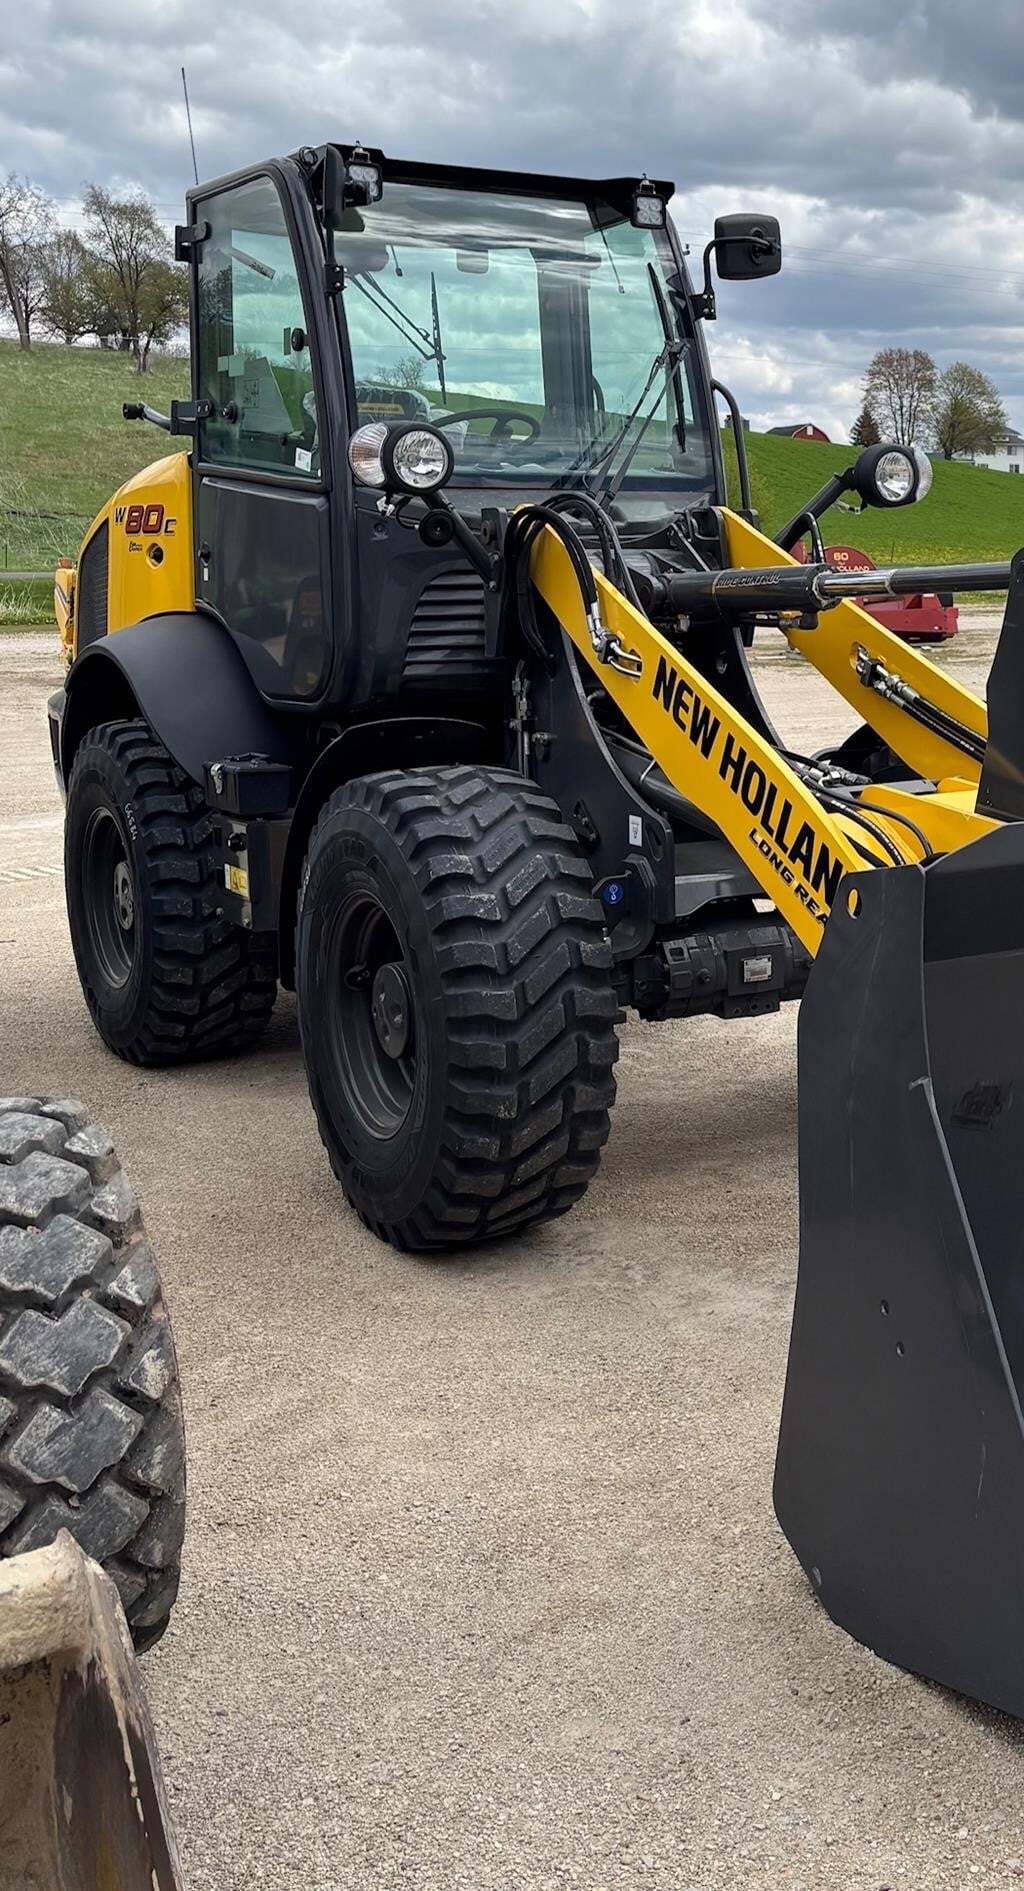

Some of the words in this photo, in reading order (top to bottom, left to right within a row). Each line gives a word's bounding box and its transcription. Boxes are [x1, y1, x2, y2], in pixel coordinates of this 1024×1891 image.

[833, 552, 849, 561] 60
[652, 655, 721, 760] NEW
[719, 732, 844, 906] HOLLAN
[749, 827, 795, 885] LONG
